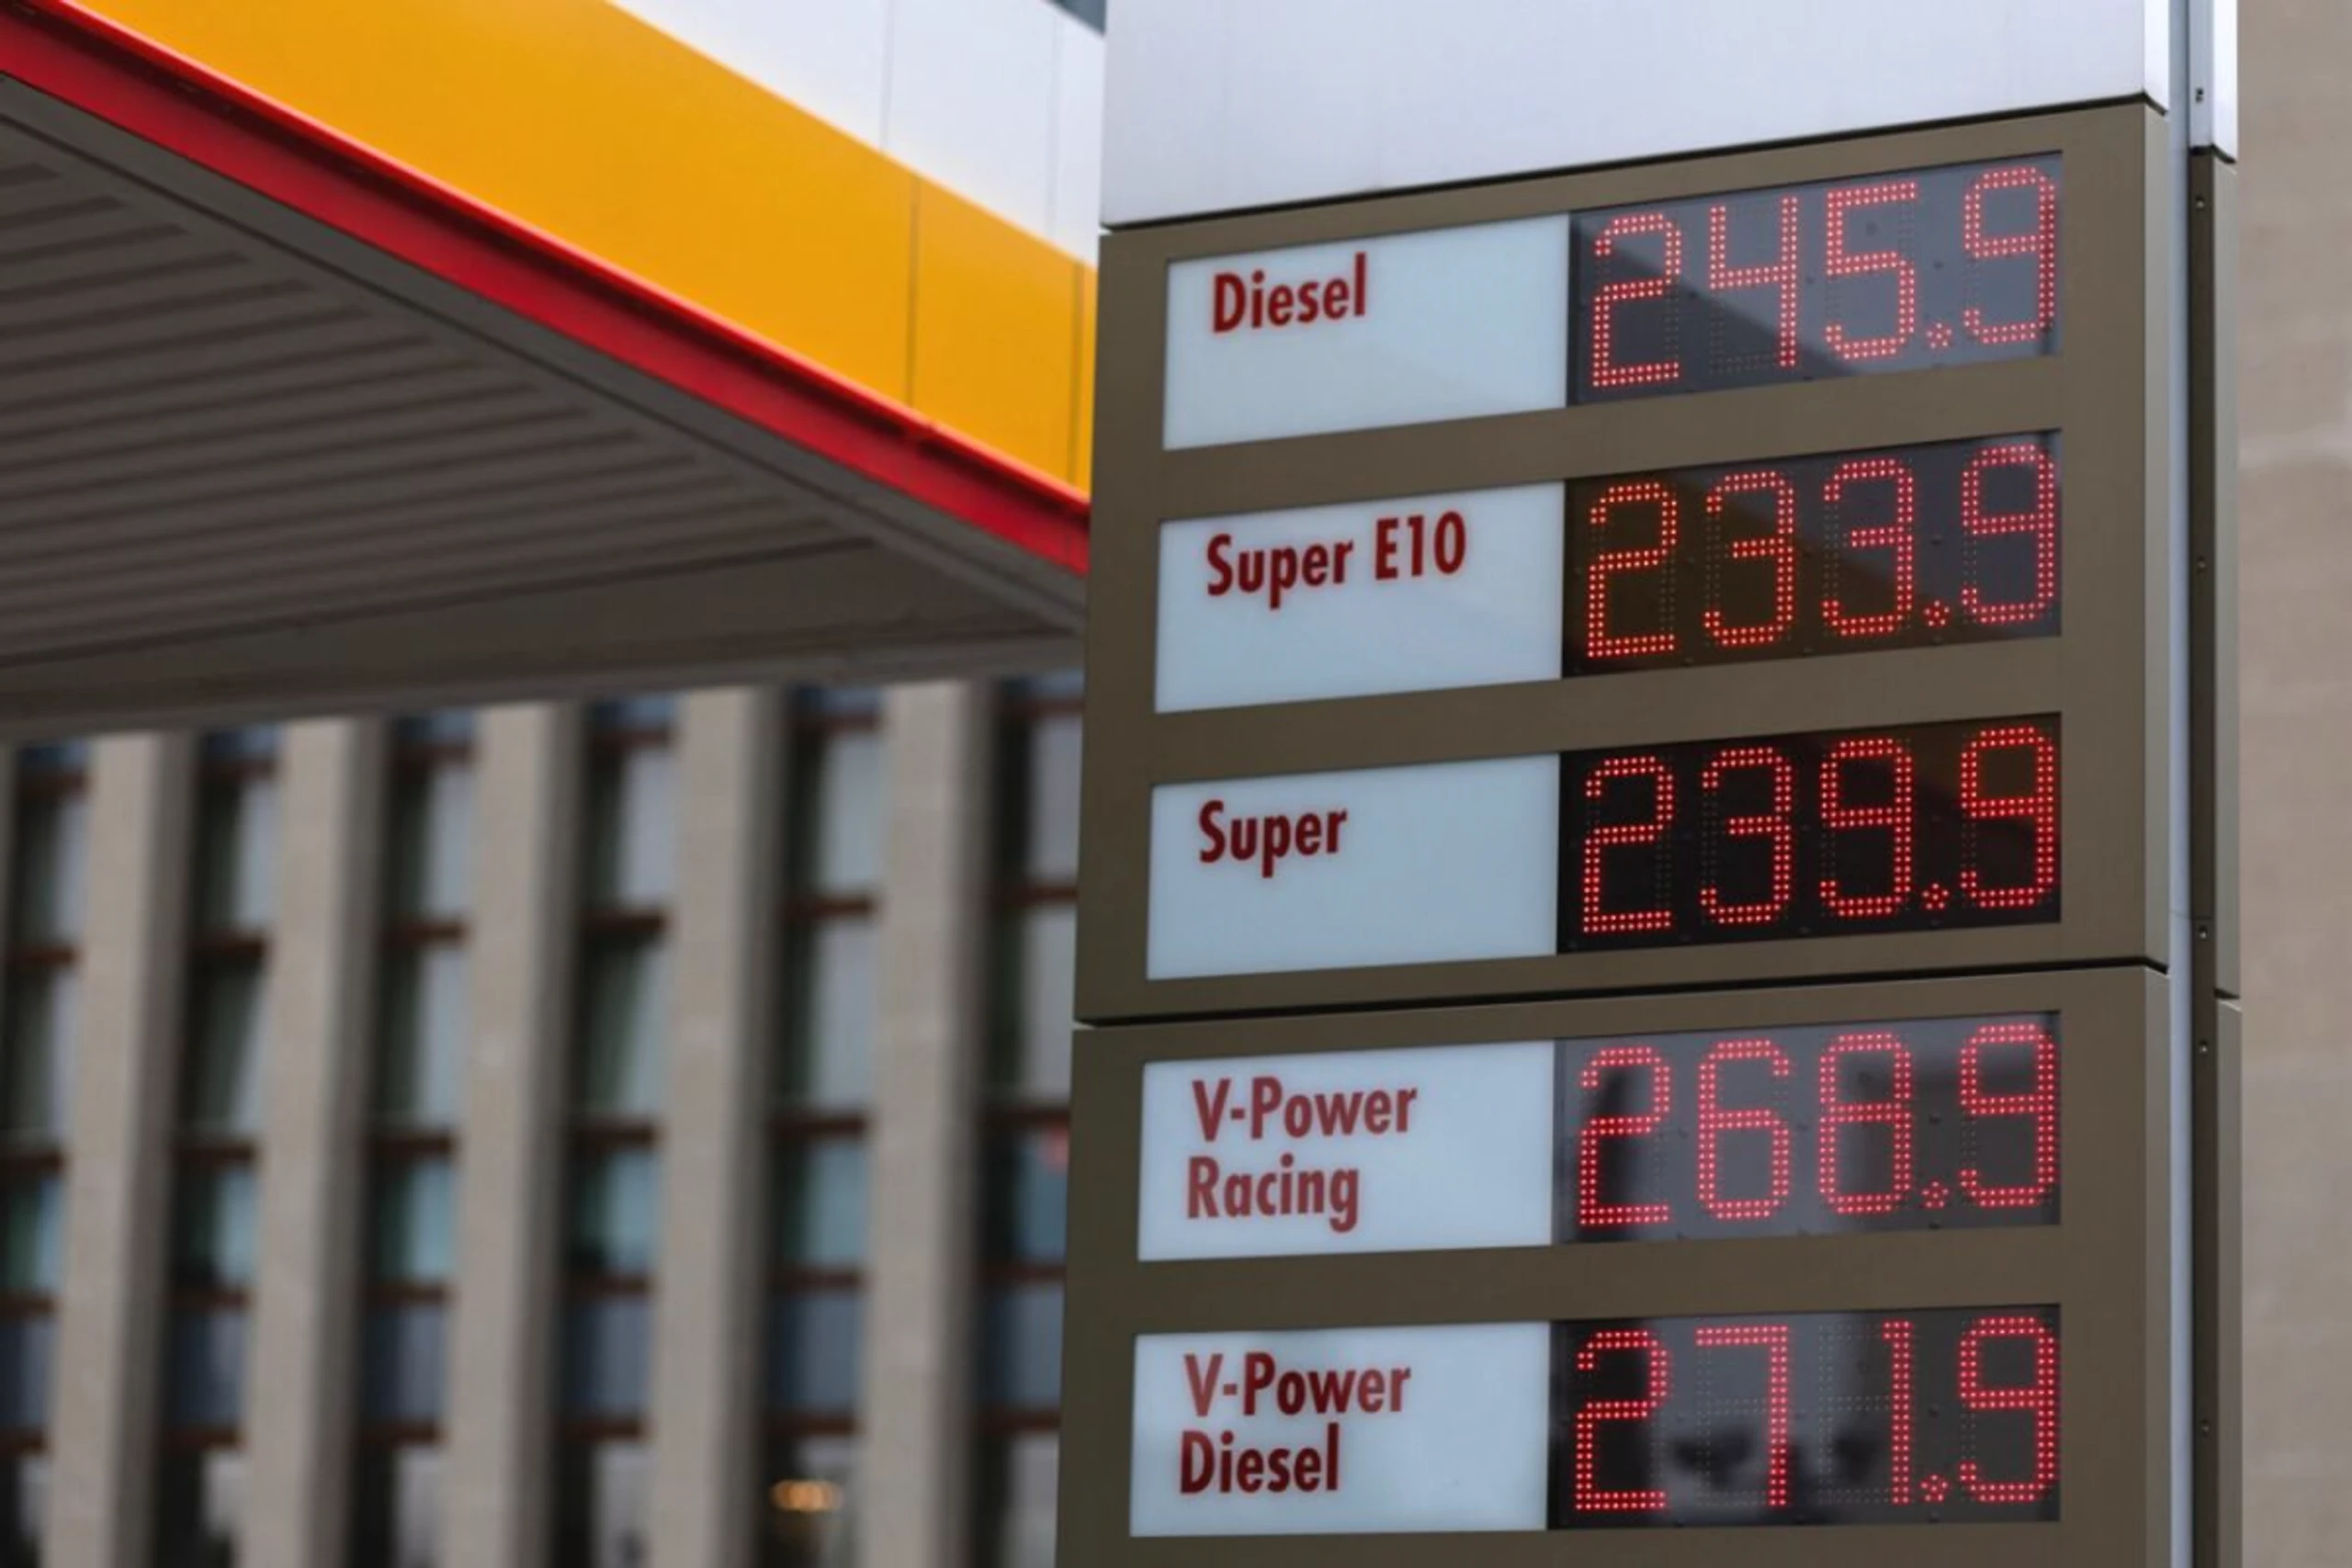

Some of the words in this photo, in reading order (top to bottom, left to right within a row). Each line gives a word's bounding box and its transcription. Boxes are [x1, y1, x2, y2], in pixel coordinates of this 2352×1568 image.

[1212, 252, 1368, 334] Diesel
[1594, 167, 2056, 386] 245.9
[1206, 533, 1356, 610] Super
[1374, 511, 1468, 581] E10
[1588, 444, 2056, 659] 233.9
[1199, 799, 1347, 879] Super
[1582, 724, 2058, 932] 239.9
[1193, 1077, 1418, 1140] V-Power
[1578, 1022, 2058, 1226] 268.9
[1188, 1154, 1359, 1234] Racing
[1184, 1351, 1411, 1417] V-Power
[1574, 1315, 2058, 1512] 271.9
[1181, 1424, 1340, 1495] Diesel
